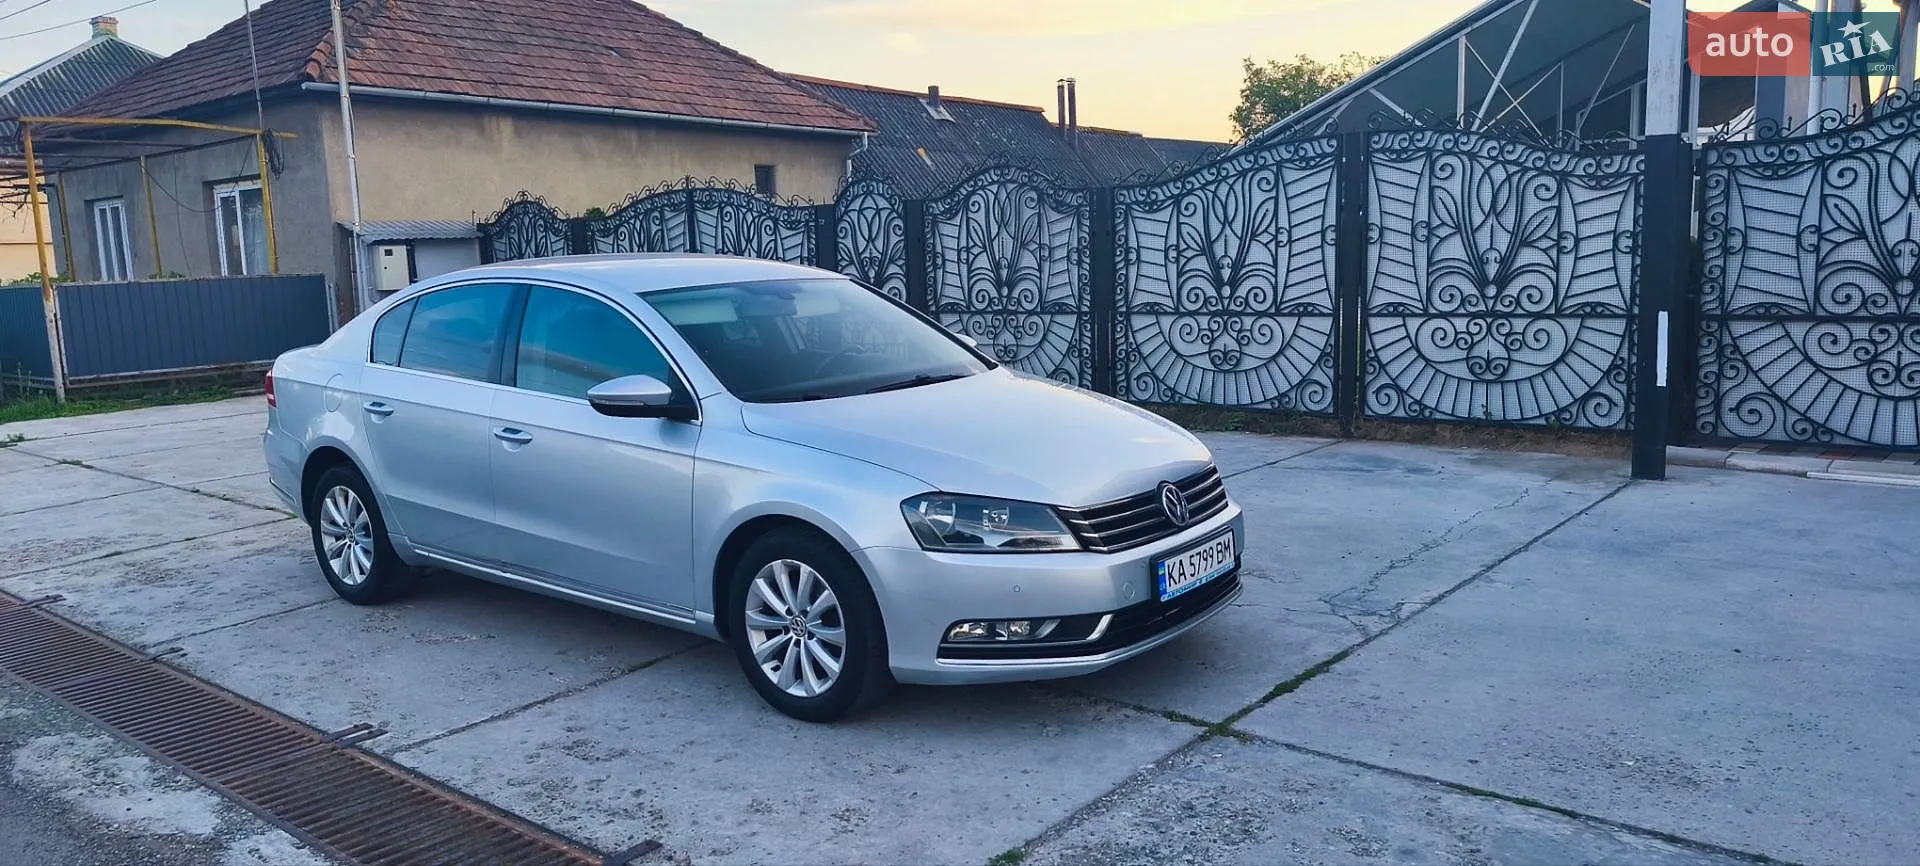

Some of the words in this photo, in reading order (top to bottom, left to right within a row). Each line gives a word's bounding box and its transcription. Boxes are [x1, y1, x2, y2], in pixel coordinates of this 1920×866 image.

[1167, 559, 1187, 588] KA
[1189, 546, 1214, 578] 5799
[1216, 538, 1231, 565] BM
